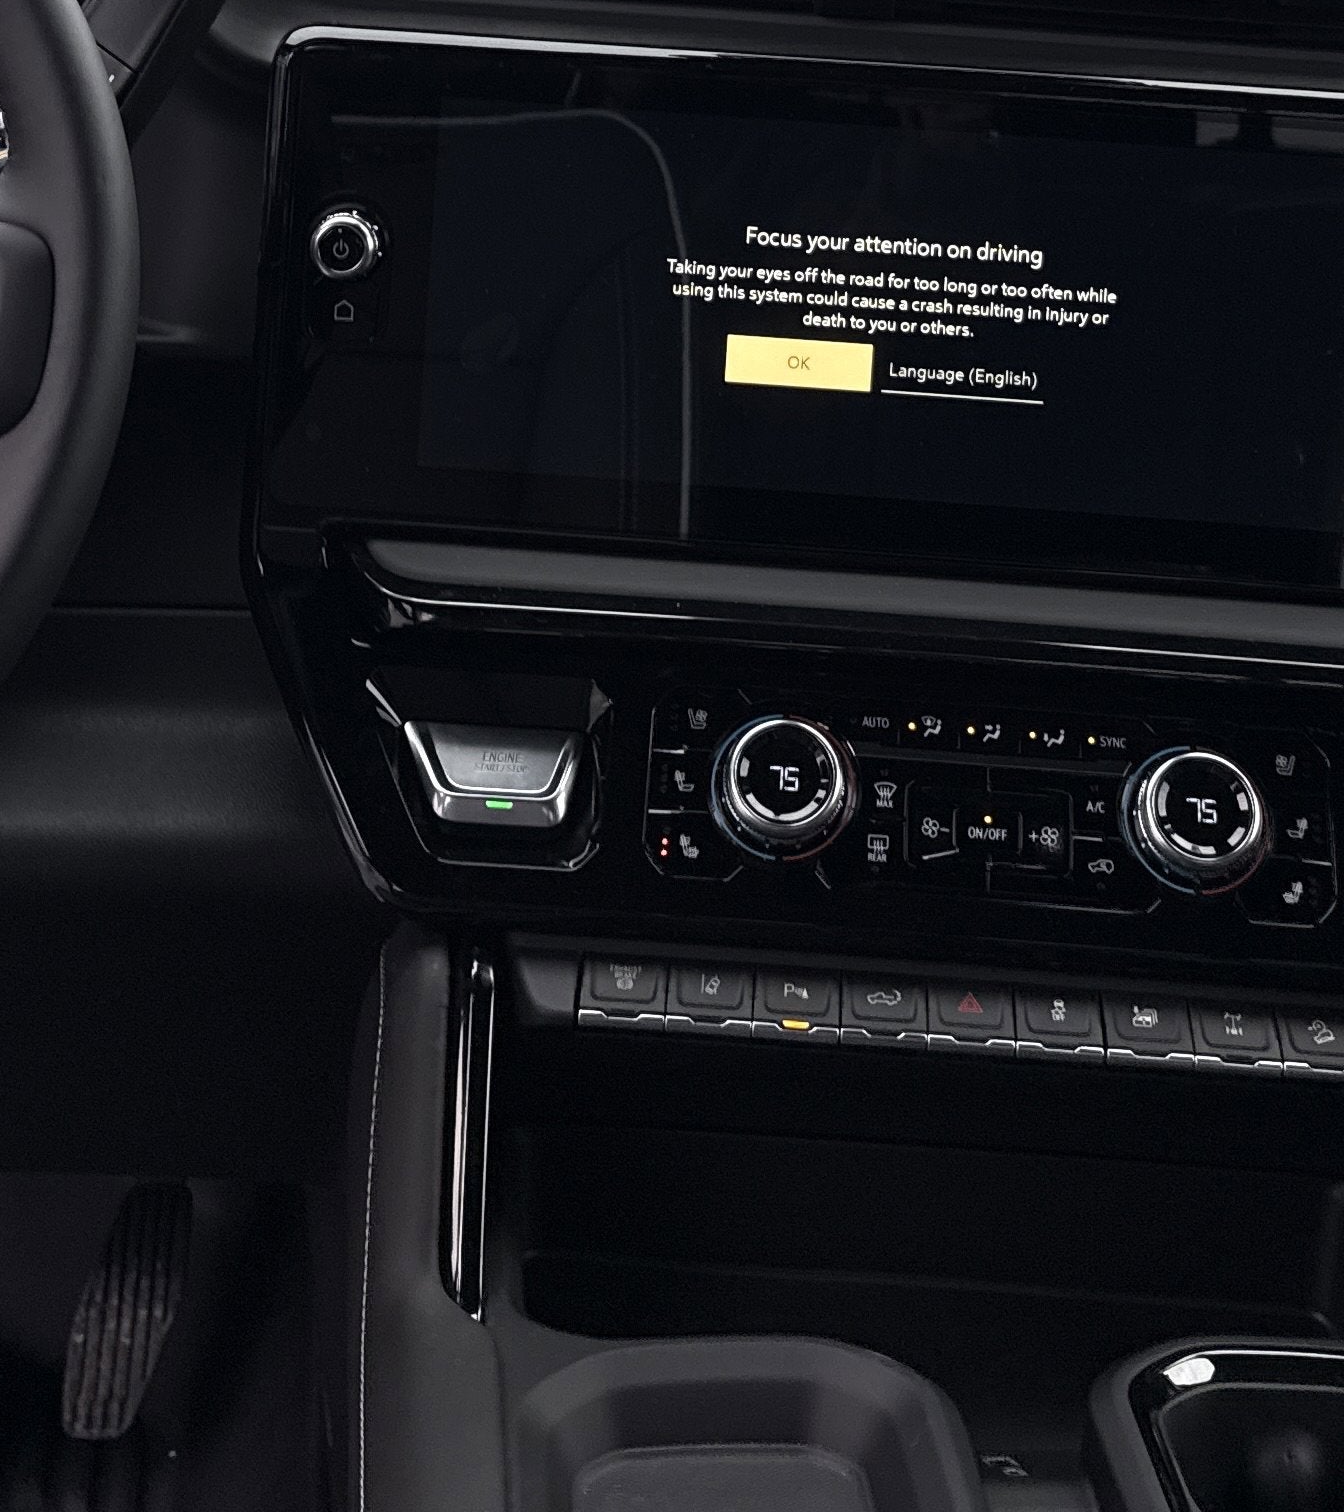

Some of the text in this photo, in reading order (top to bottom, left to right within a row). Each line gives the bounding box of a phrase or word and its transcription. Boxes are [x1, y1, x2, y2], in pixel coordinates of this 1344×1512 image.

[746, 226, 1042, 270] Focus your attention on driving
[667, 258, 1117, 303] Taking your eyes off the road for too long or too often while
[673, 282, 1109, 327] using this system could cause a crash resulting in injury or
[803, 311, 974, 337] death to you or others.
[787, 355, 811, 371] OK
[890, 362, 1037, 390] Language (English)
[862, 717, 1127, 750] AUTO SYNC
[482, 751, 525, 764] ENGINE
[770, 766, 799, 791] 75
[876, 799, 894, 809] MAX
[1086, 800, 1105, 813] A/C
[1186, 798, 1217, 823] 75
[968, 827, 1008, 842] ON/OFF
[867, 852, 888, 863] REAR
